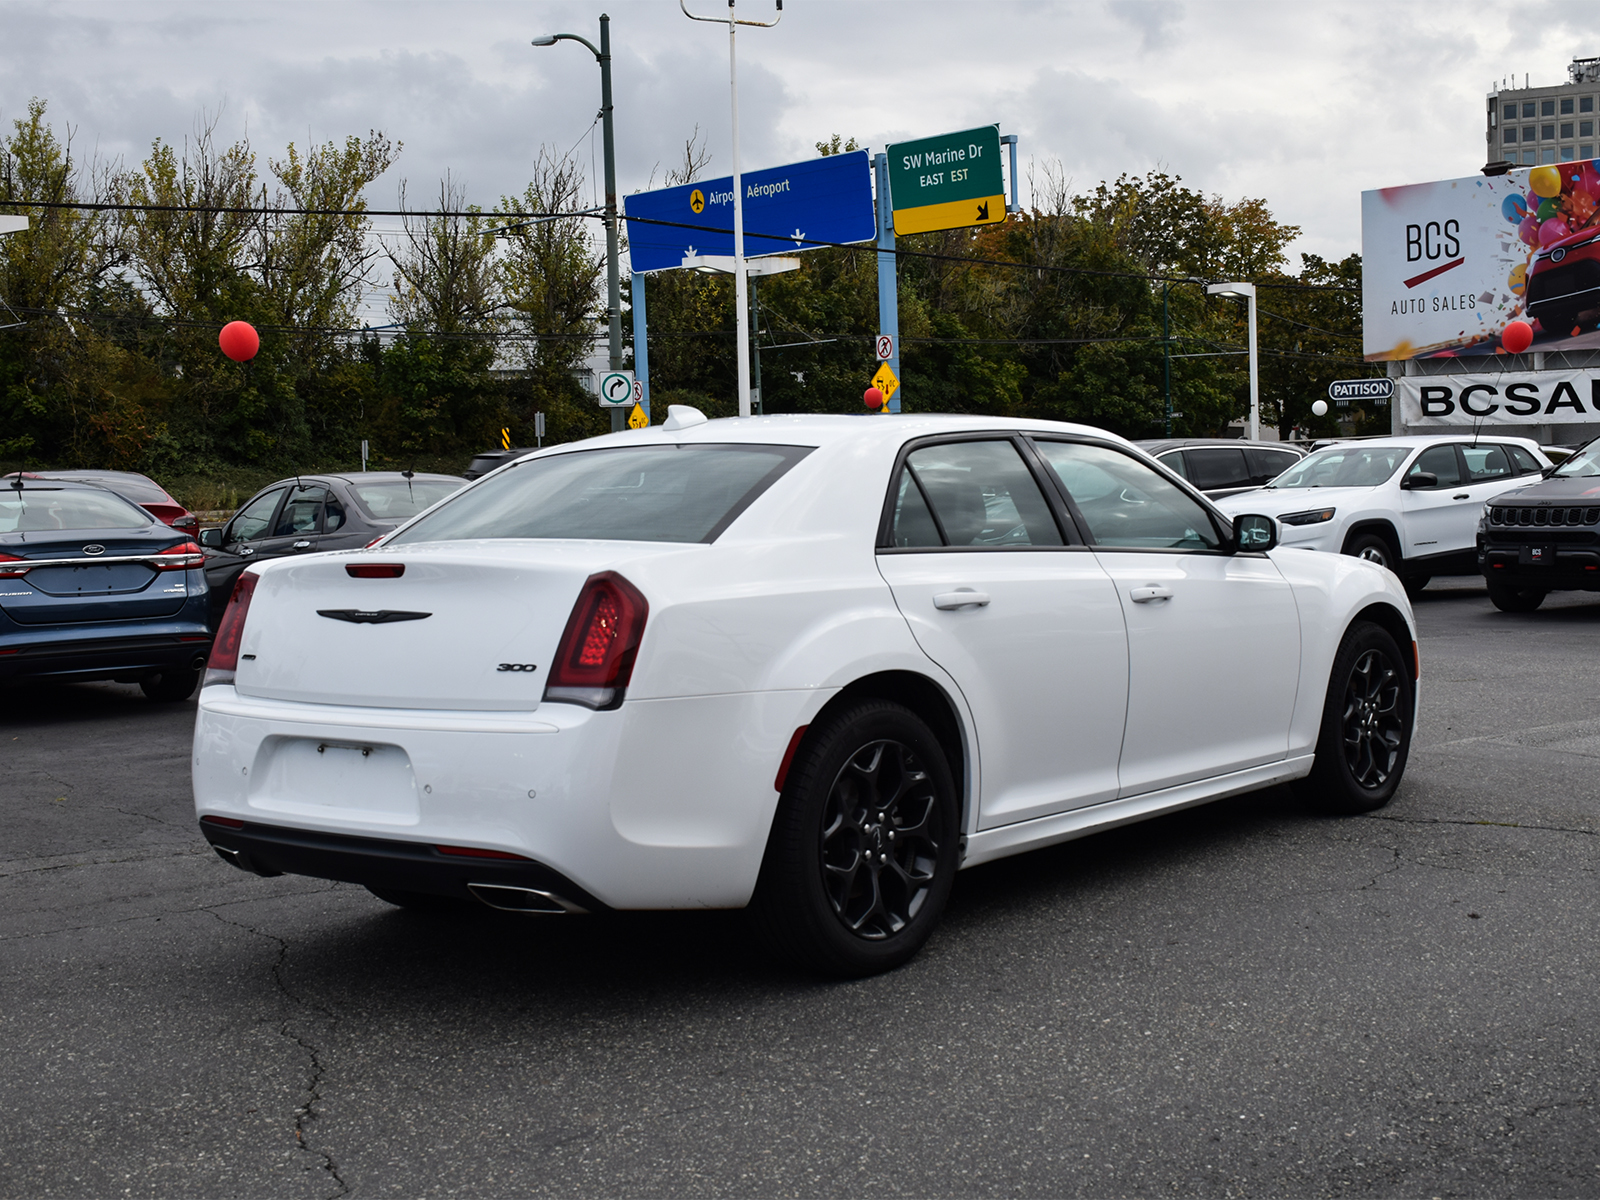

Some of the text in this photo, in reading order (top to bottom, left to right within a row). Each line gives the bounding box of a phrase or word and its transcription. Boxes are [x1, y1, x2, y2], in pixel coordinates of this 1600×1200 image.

[903, 144, 983, 170] SW Marine Dr
[919, 168, 968, 187] EAST EST
[709, 179, 790, 206] Airpo Aéroport
[1406, 219, 1460, 262] BCS
[1391, 293, 1476, 315] AUTO SALES
[1334, 383, 1389, 396] PATTISON
[496, 663, 537, 672] 300
